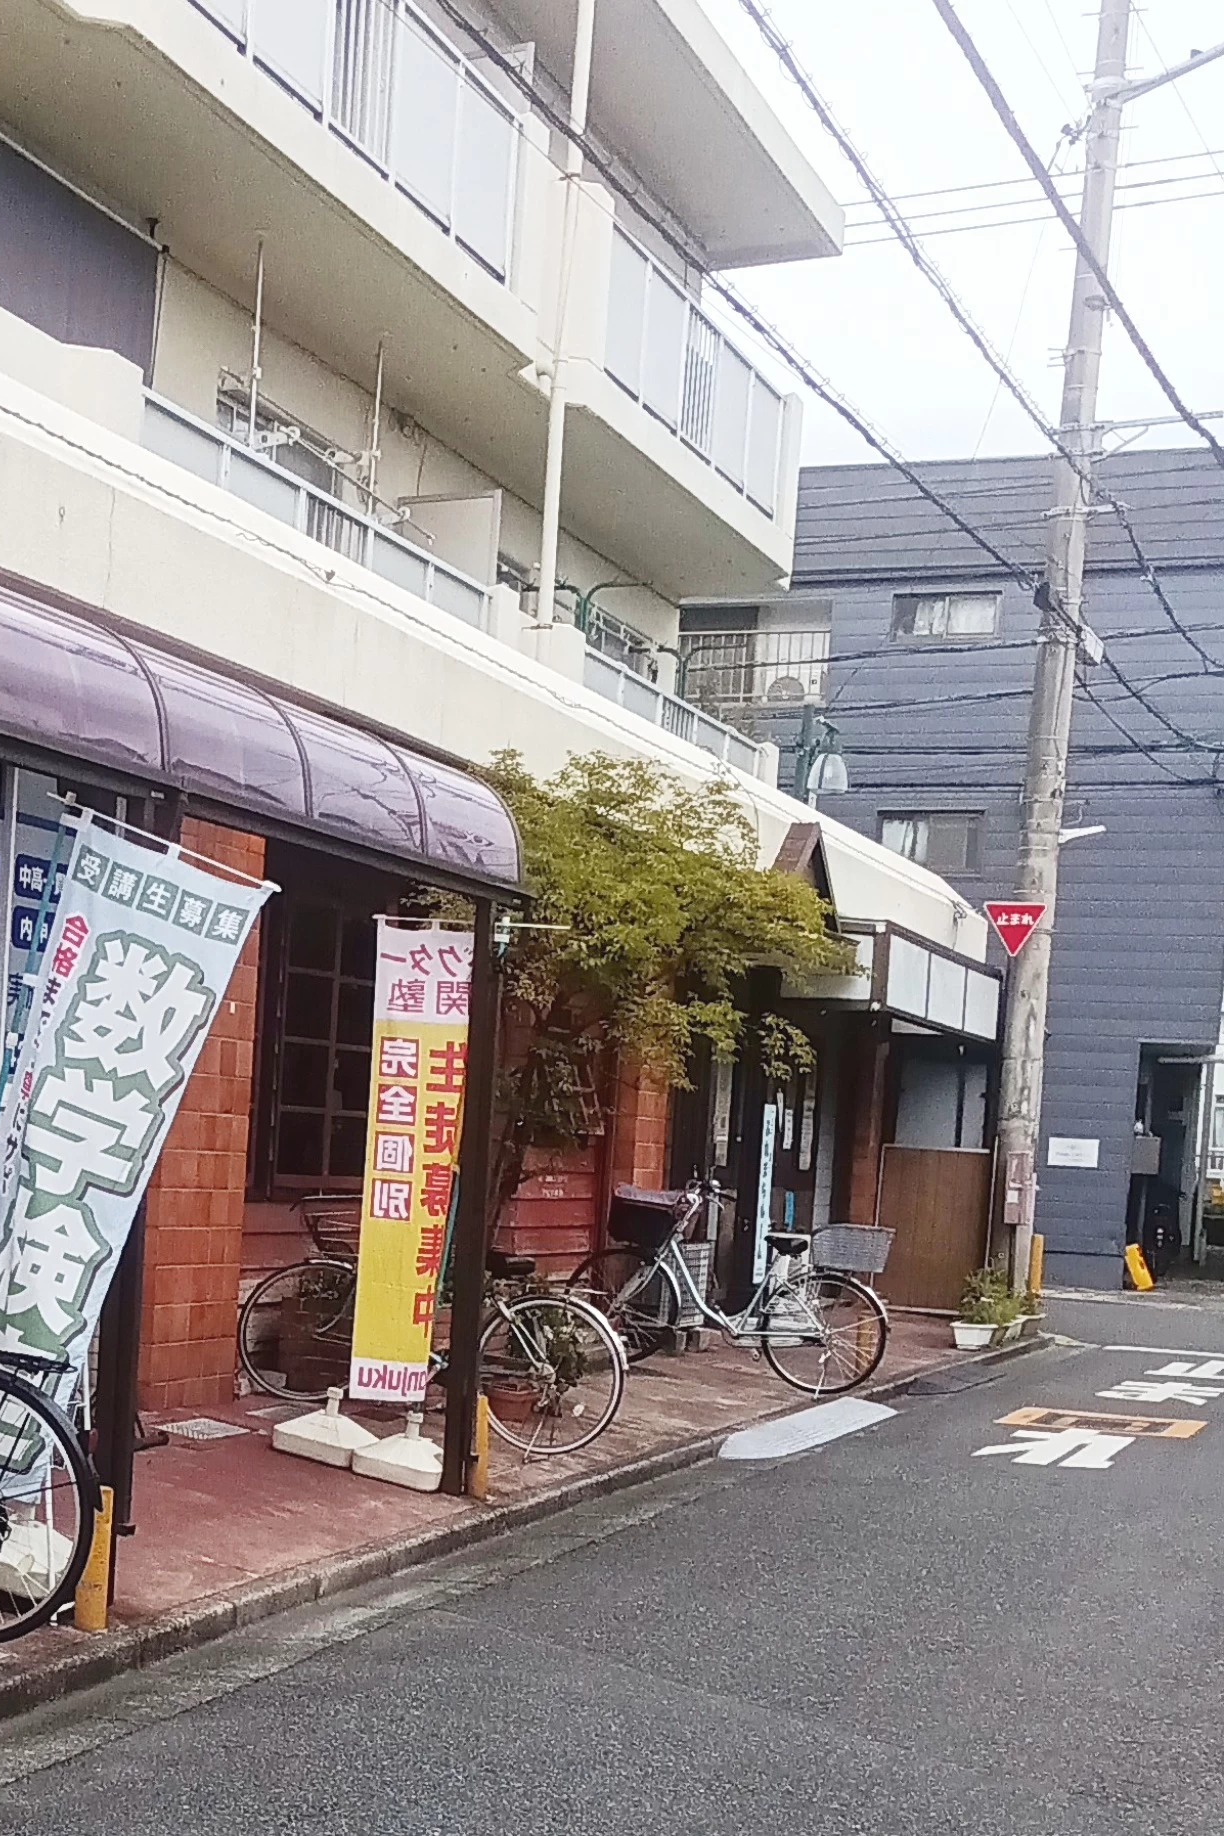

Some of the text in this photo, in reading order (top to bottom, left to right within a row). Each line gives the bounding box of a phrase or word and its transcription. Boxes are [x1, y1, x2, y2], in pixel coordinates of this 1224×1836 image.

[77, 852, 244, 941] 受講生募集
[996, 912, 1035, 926] 止まれ
